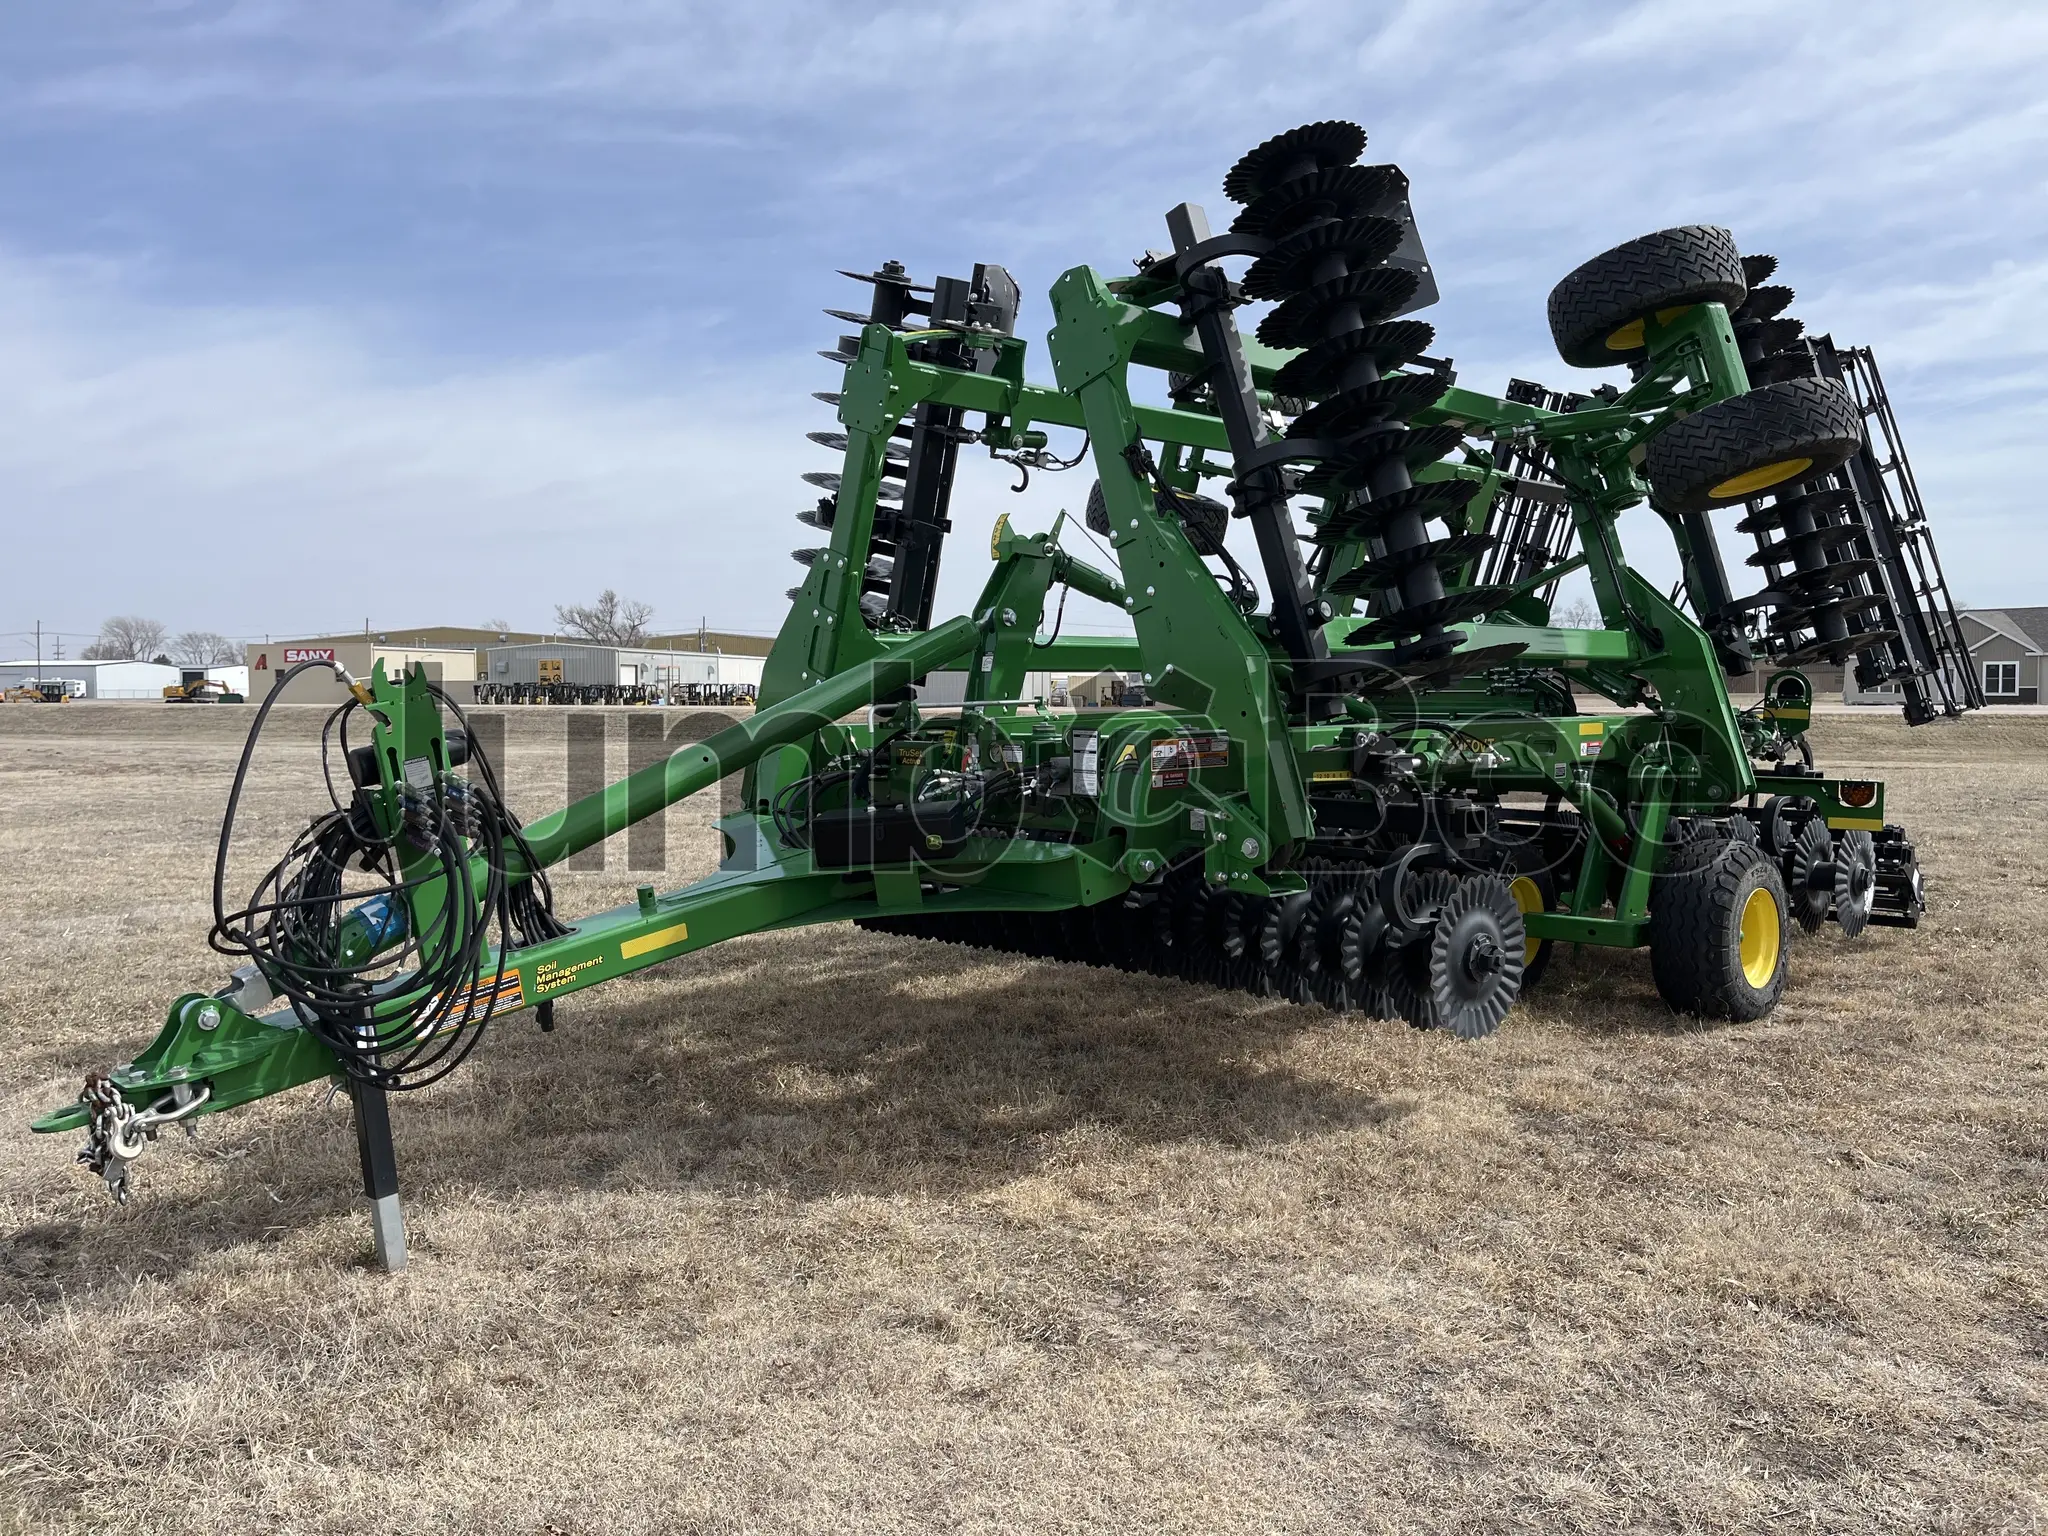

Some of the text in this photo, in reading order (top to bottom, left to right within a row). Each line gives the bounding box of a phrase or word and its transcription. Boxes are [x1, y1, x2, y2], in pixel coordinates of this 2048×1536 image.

[286, 650, 331, 662] SANY
[536, 955, 604, 985] Management
[537, 960, 557, 975] Soil
[536, 974, 577, 993] System
